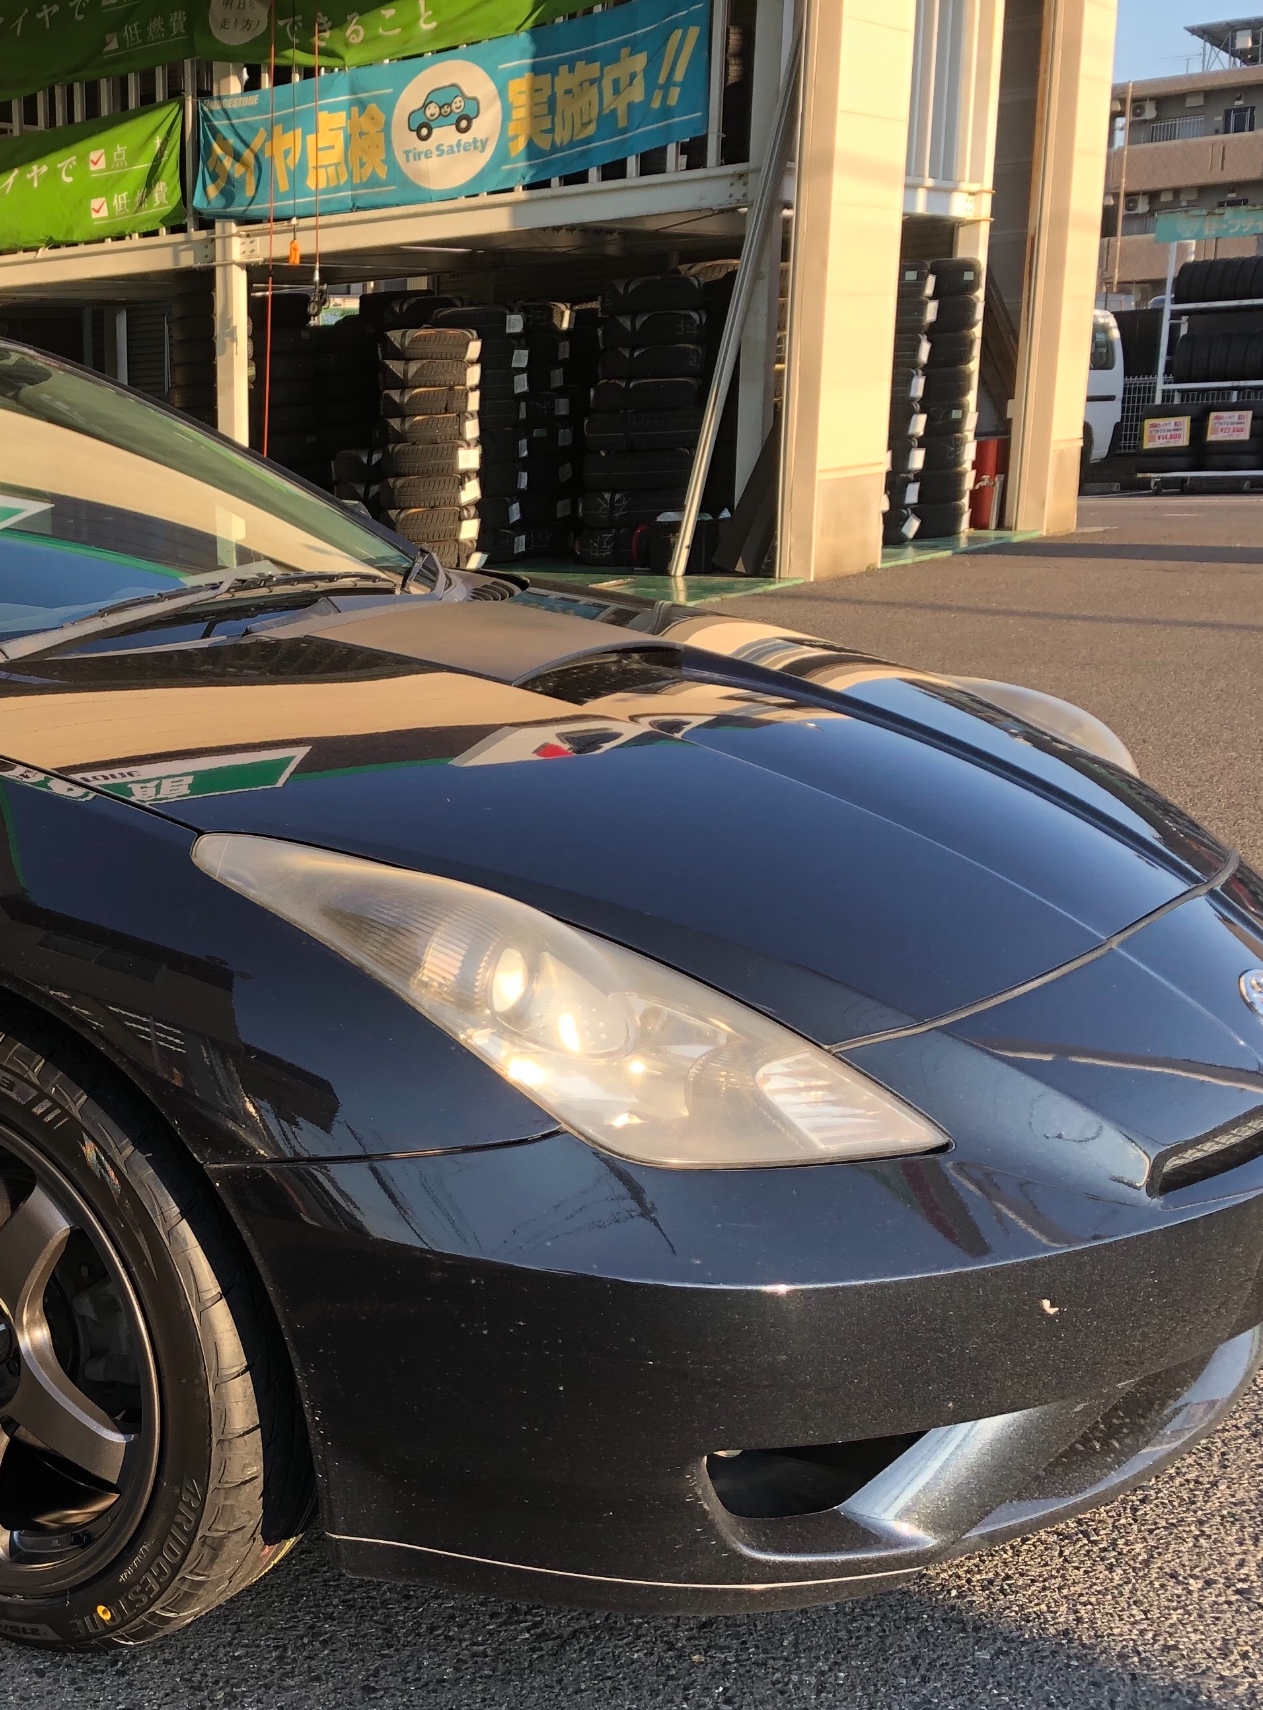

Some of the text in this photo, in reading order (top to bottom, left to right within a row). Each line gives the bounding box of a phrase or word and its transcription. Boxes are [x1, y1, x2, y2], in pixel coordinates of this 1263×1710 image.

[123, 10, 187, 48] 低燃費
[508, 26, 701, 157] 実施中!!
[206, 103, 388, 200] タイヤ点検
[403, 136, 489, 163] Tire Safety
[68, 1476, 202, 1639] BRIDGESTONE
